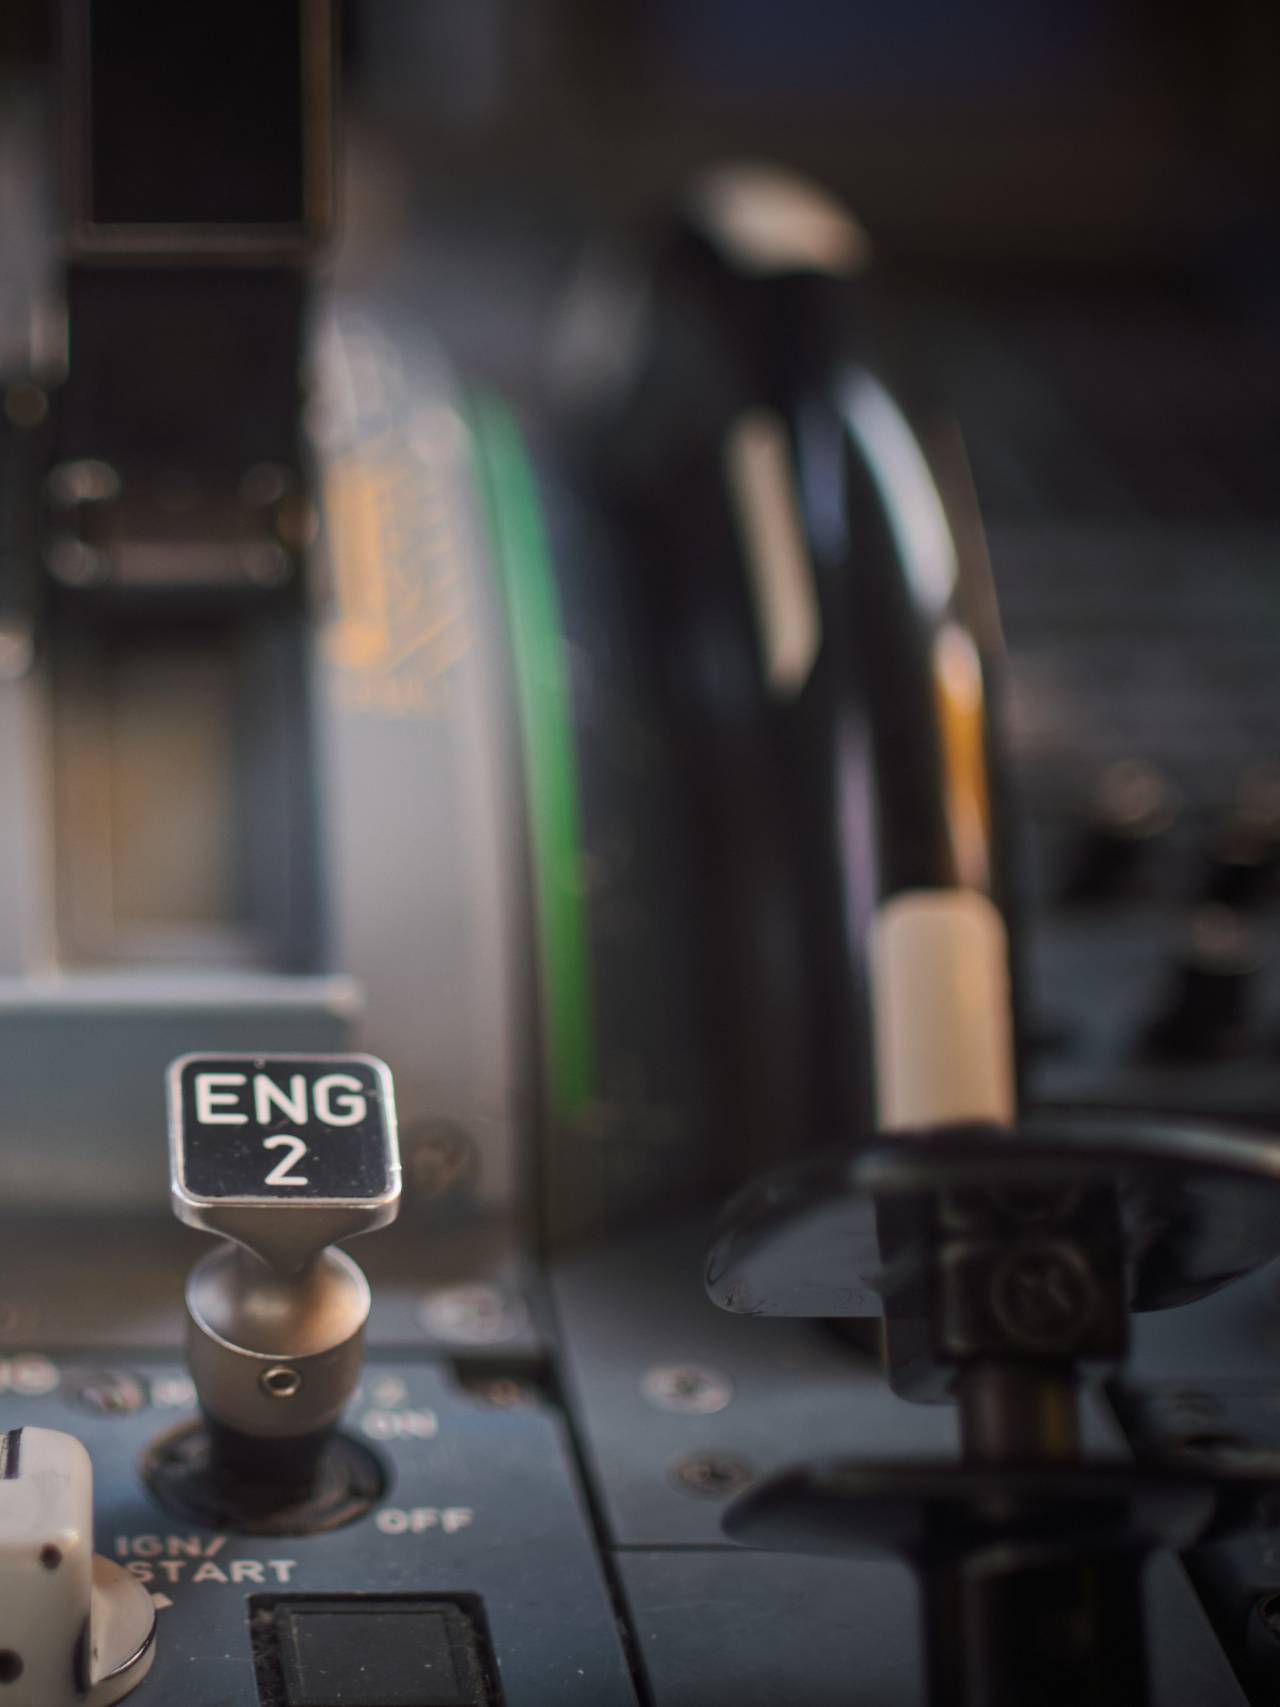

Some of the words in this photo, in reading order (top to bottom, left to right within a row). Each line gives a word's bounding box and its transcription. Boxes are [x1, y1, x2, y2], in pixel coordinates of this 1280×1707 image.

[194, 1073, 367, 1127] ENG
[263, 1134, 308, 1186] 2
[376, 1508, 473, 1534] OFF
[116, 1535, 227, 1557] IGN/
[126, 1560, 297, 1583] START
